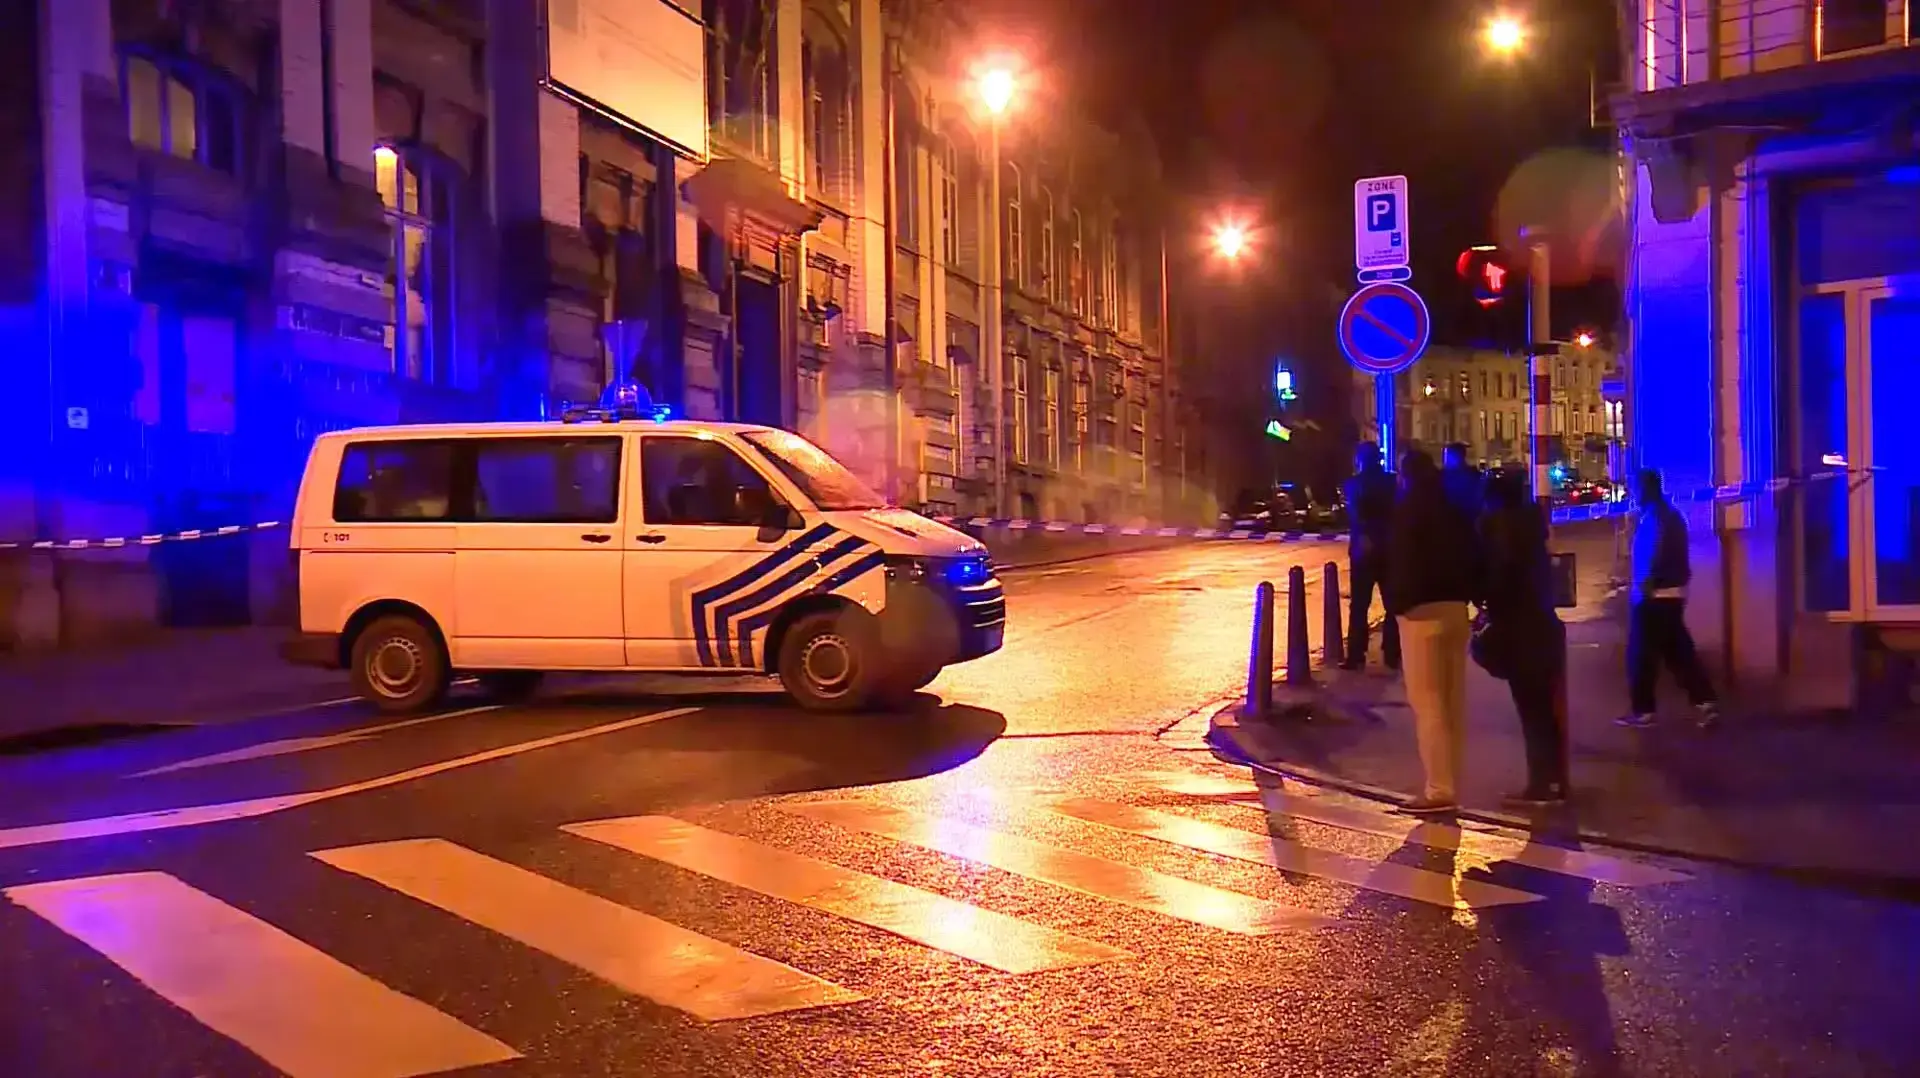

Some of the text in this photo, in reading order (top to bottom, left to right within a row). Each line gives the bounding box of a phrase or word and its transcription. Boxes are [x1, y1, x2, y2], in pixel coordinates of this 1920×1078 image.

[1367, 181, 1396, 191] ZONE
[1372, 200, 1390, 226] P
[334, 533, 350, 541] 101
